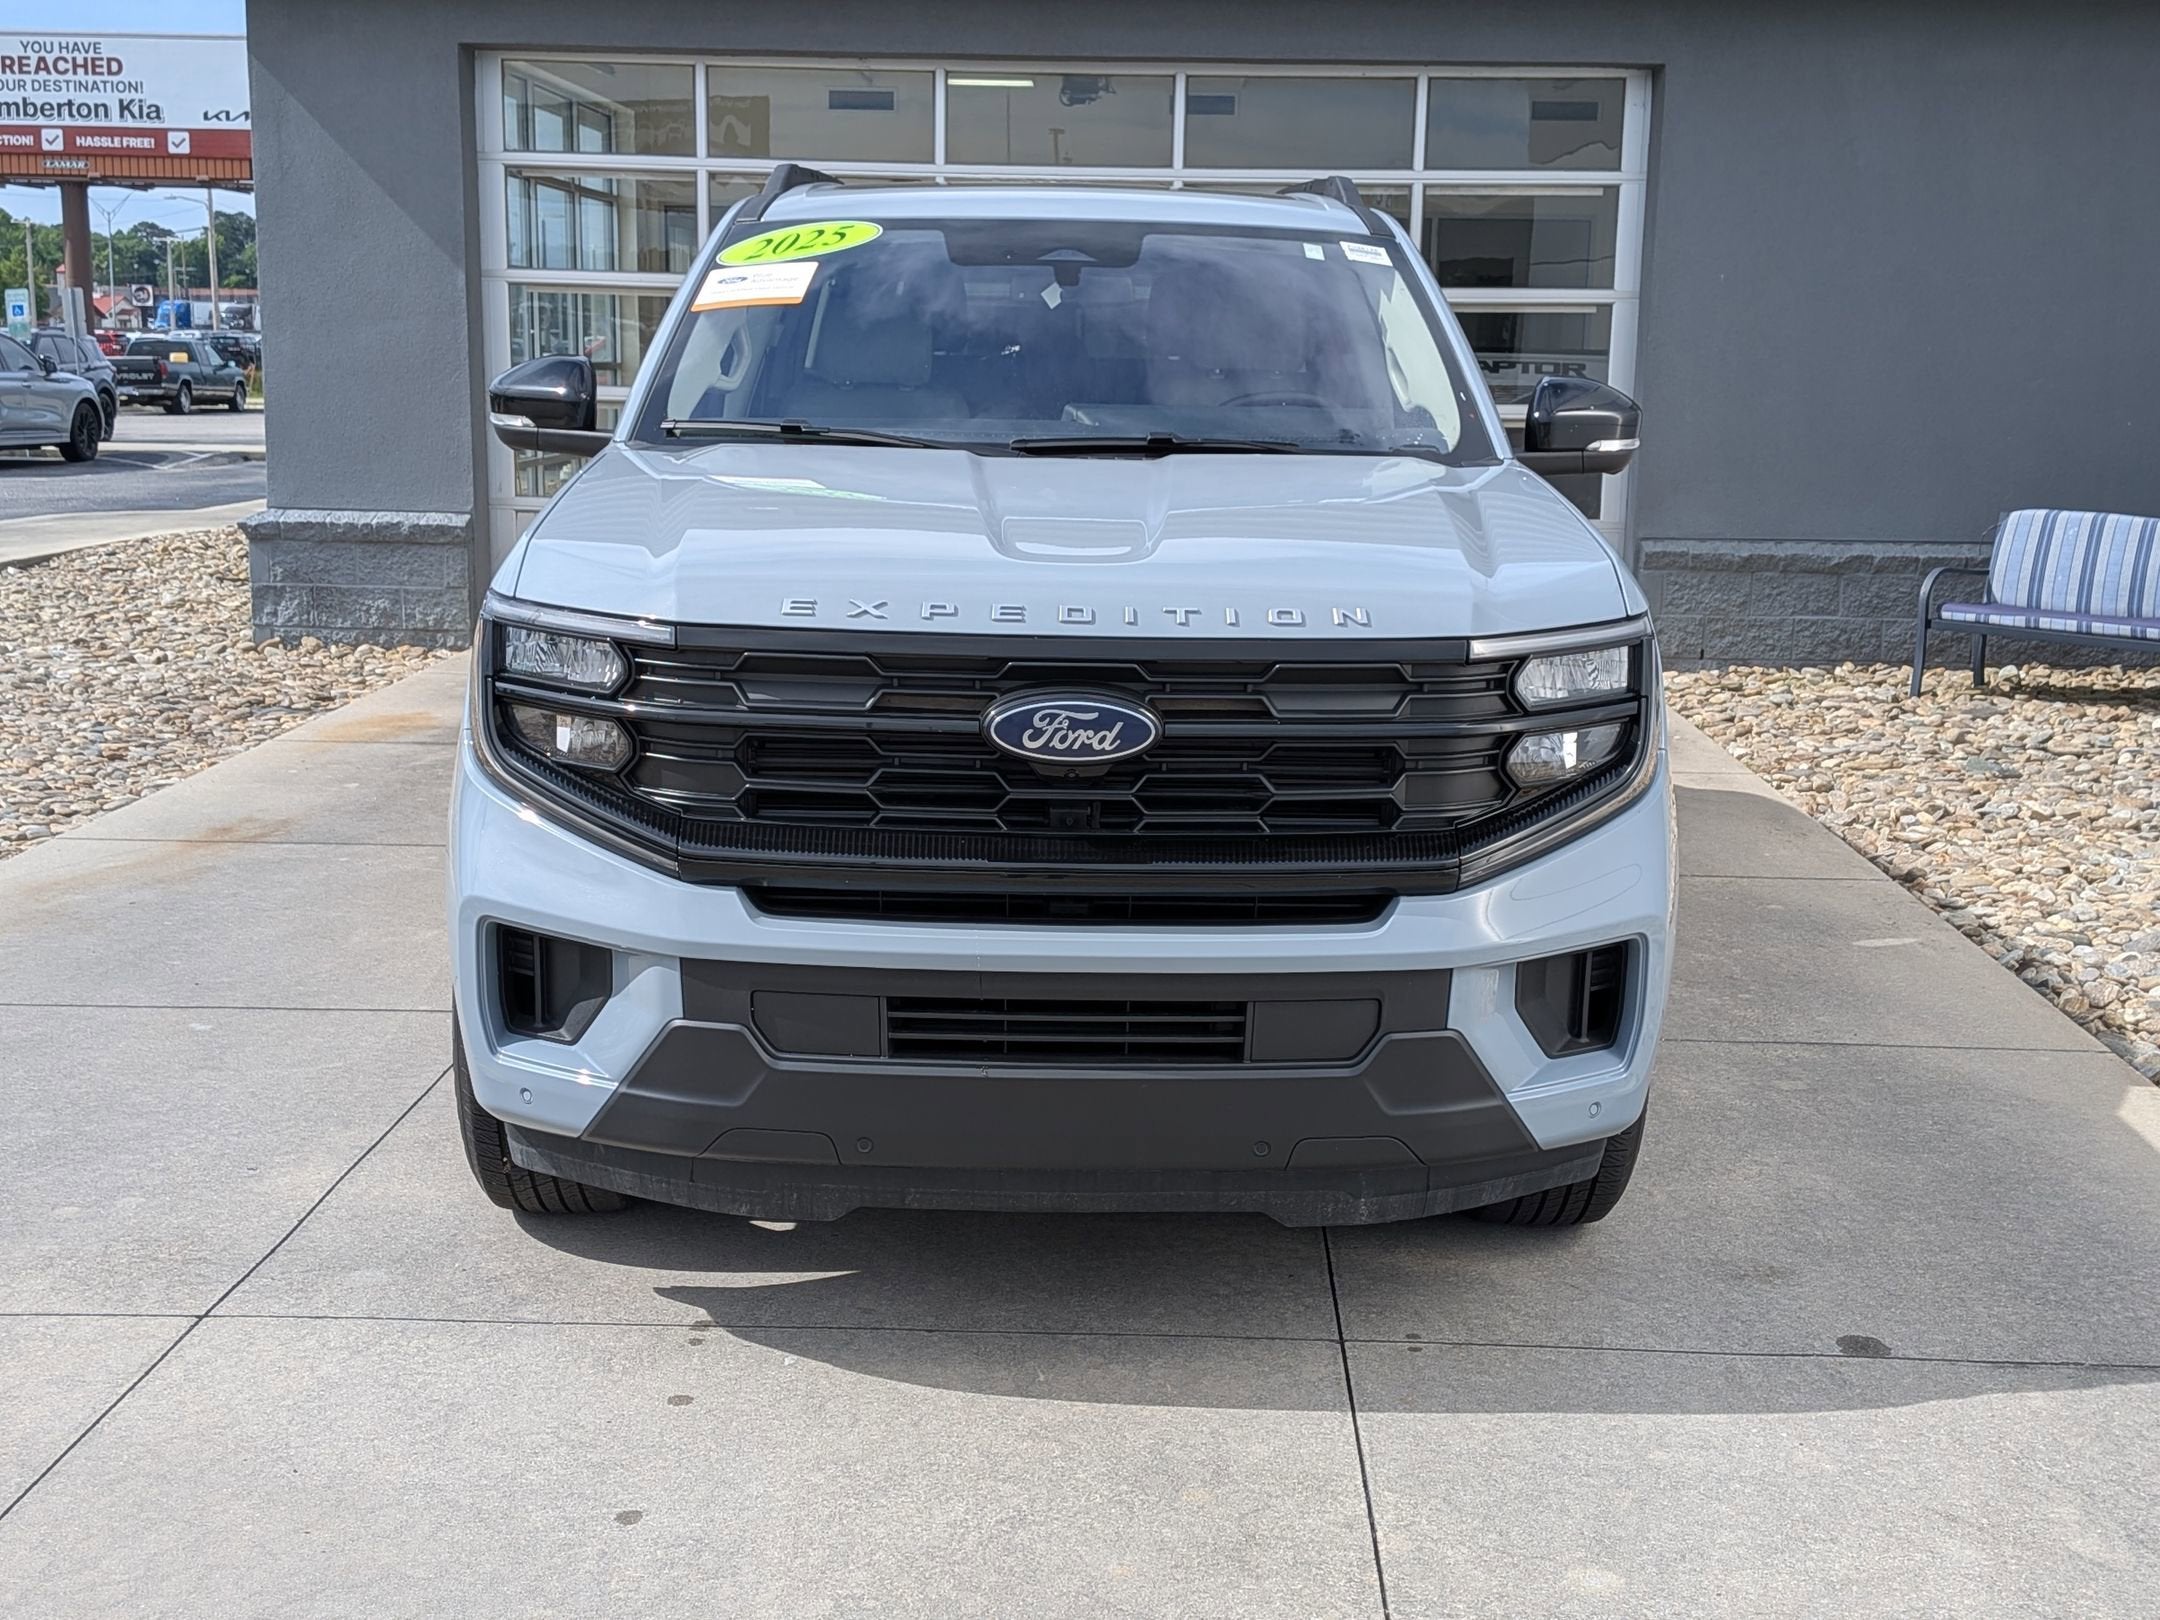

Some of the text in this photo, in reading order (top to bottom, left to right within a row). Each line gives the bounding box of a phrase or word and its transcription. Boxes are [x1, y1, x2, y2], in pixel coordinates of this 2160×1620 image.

[20, 40, 102, 55] YOU HAVE
[0, 55, 124, 77] REACHED
[31, 79, 144, 94] DESTINATION!
[0, 96, 163, 122] mberton Kia
[76, 135, 156, 149] HASSLE FREE!
[743, 225, 855, 261] 2025
[780, 597, 1372, 628] EXPEDITION
[1021, 707, 1124, 752] Ford
